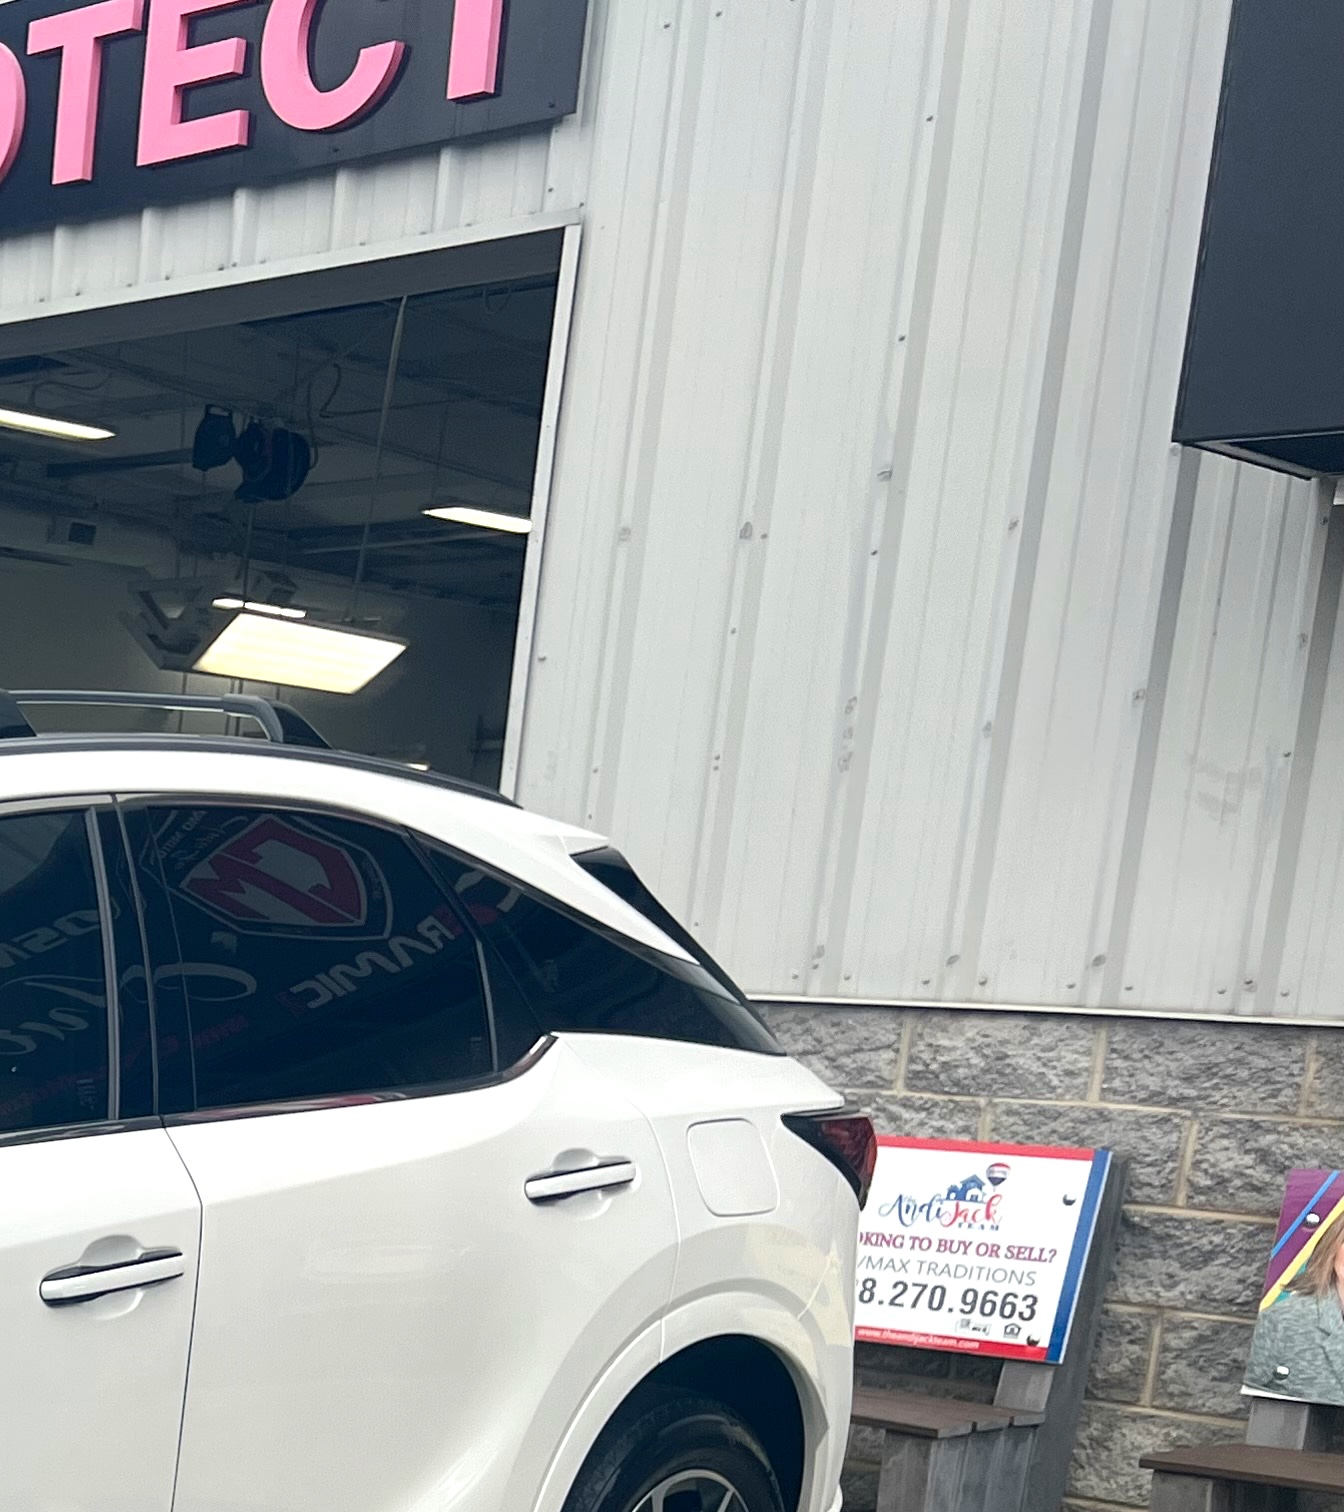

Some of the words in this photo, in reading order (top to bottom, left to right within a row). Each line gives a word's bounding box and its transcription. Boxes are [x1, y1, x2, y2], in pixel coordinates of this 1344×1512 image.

[940, 1193, 1003, 1228] Jack
[859, 1231, 905, 1249] KING
[909, 1235, 932, 1252] TO
[936, 1238, 973, 1256] BUY
[976, 1242, 1000, 1259] OR
[1004, 1245, 1057, 1263] SELL?
[857, 1255, 911, 1274] /MAX
[916, 1260, 1037, 1287] TRADITIONS
[856, 1277, 1039, 1322] 8.270.9663
